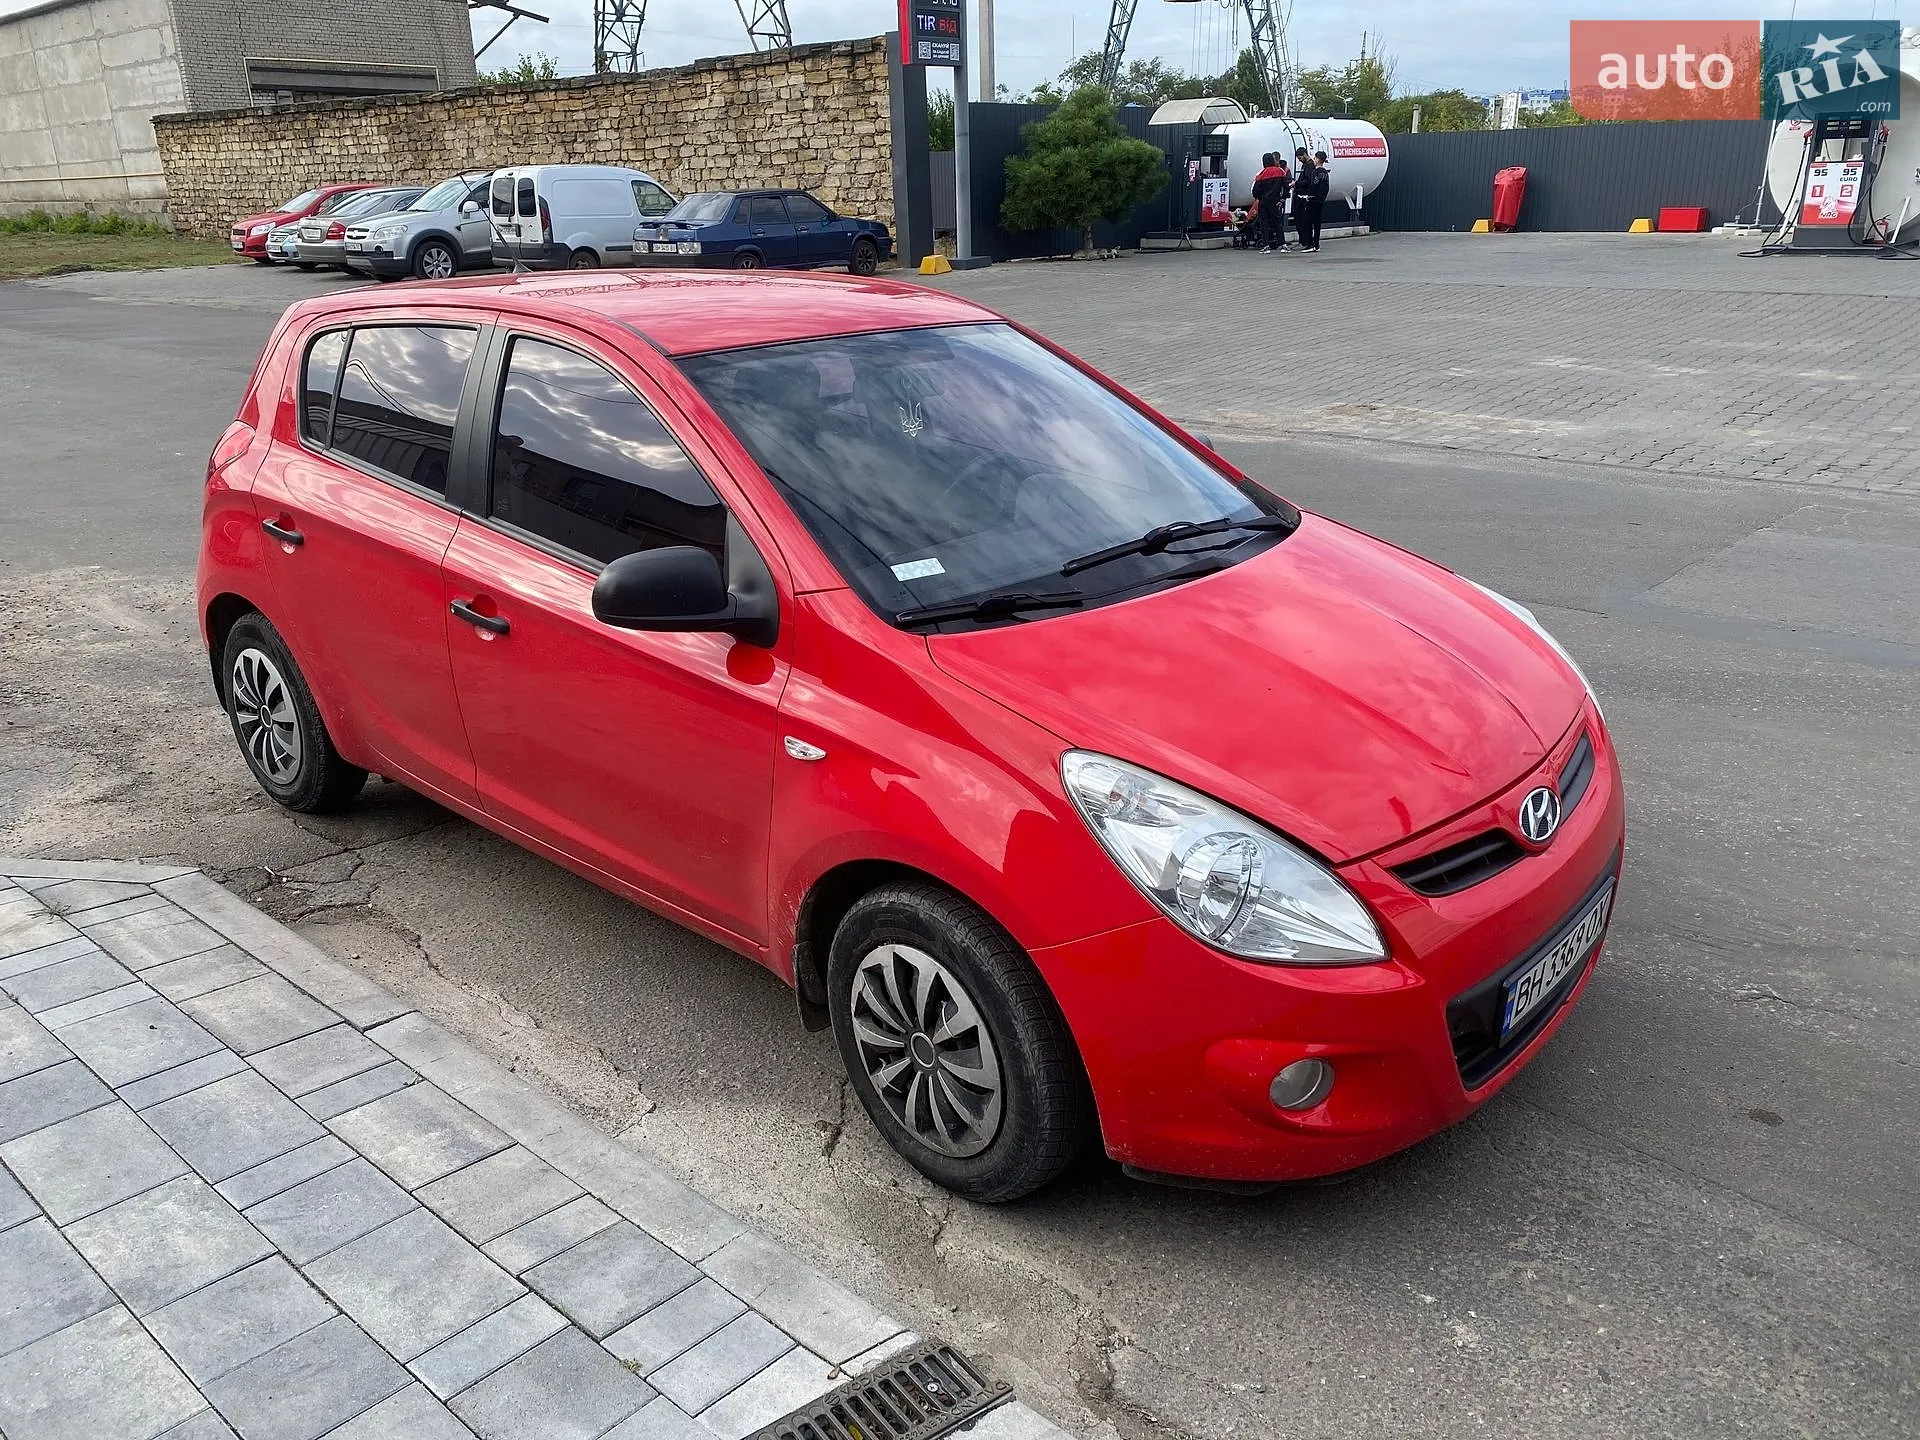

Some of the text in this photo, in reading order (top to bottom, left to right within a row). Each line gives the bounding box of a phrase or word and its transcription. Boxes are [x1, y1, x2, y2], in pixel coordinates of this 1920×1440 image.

[917, 14, 936, 30] TIR
[1331, 139, 1356, 147] ПРОПАН
[1334, 147, 1386, 156] ВОГНЕНЕБЕЗПЕЧНО
[1814, 168, 1828, 177] 95
[1843, 168, 1858, 176] 95
[1842, 185, 1852, 196] 2
[1514, 960, 1547, 1018] BH
[1546, 922, 1586, 987] 3369
[951, 1380, 1010, 1415] DALAND
